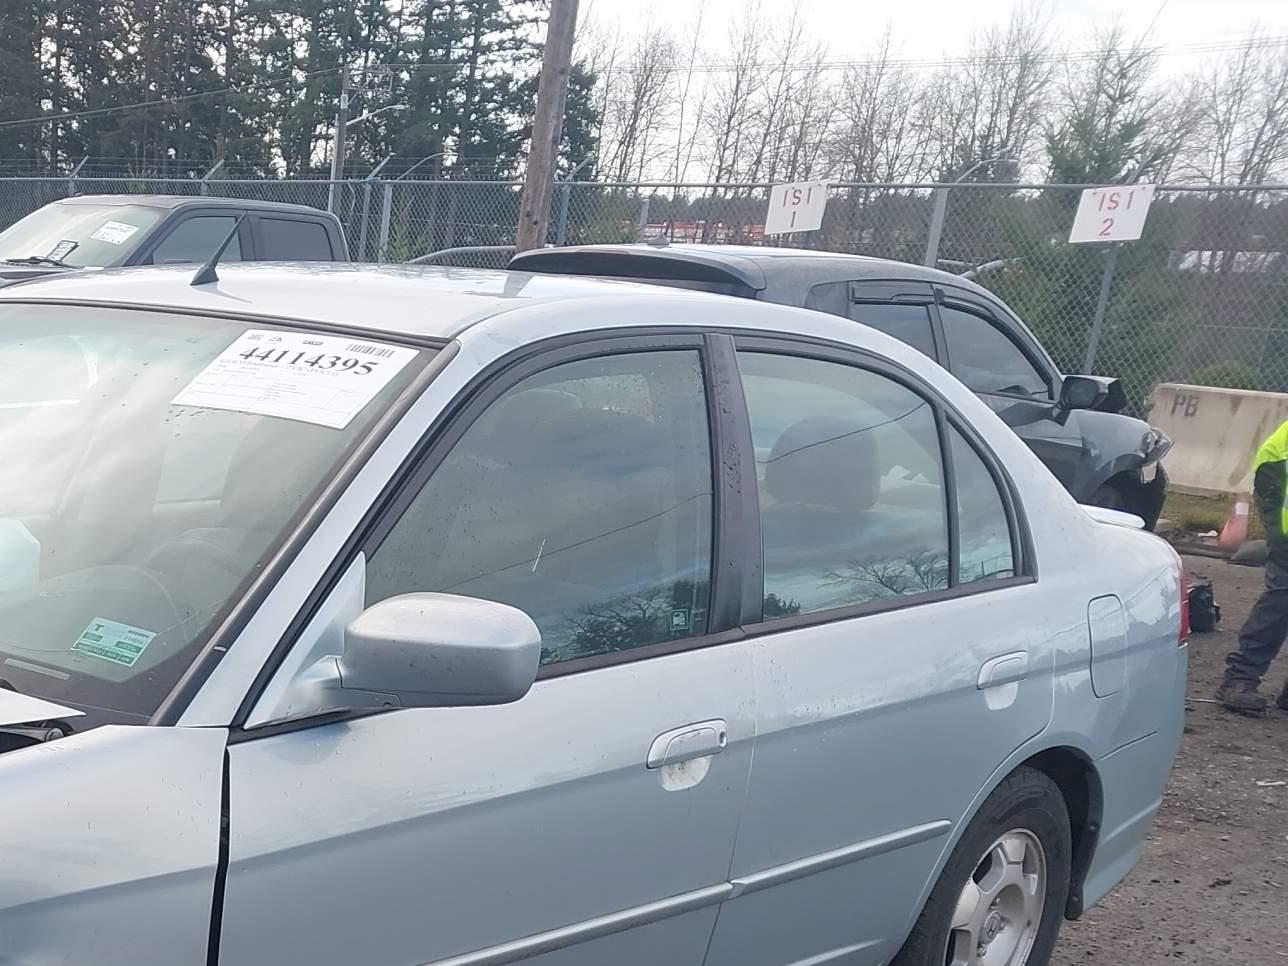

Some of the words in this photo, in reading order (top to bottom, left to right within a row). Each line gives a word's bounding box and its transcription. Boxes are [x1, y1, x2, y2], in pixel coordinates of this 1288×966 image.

[1098, 217, 1115, 237] 2
[239, 346, 380, 376] 44114395
[1171, 394, 1200, 417] PB
